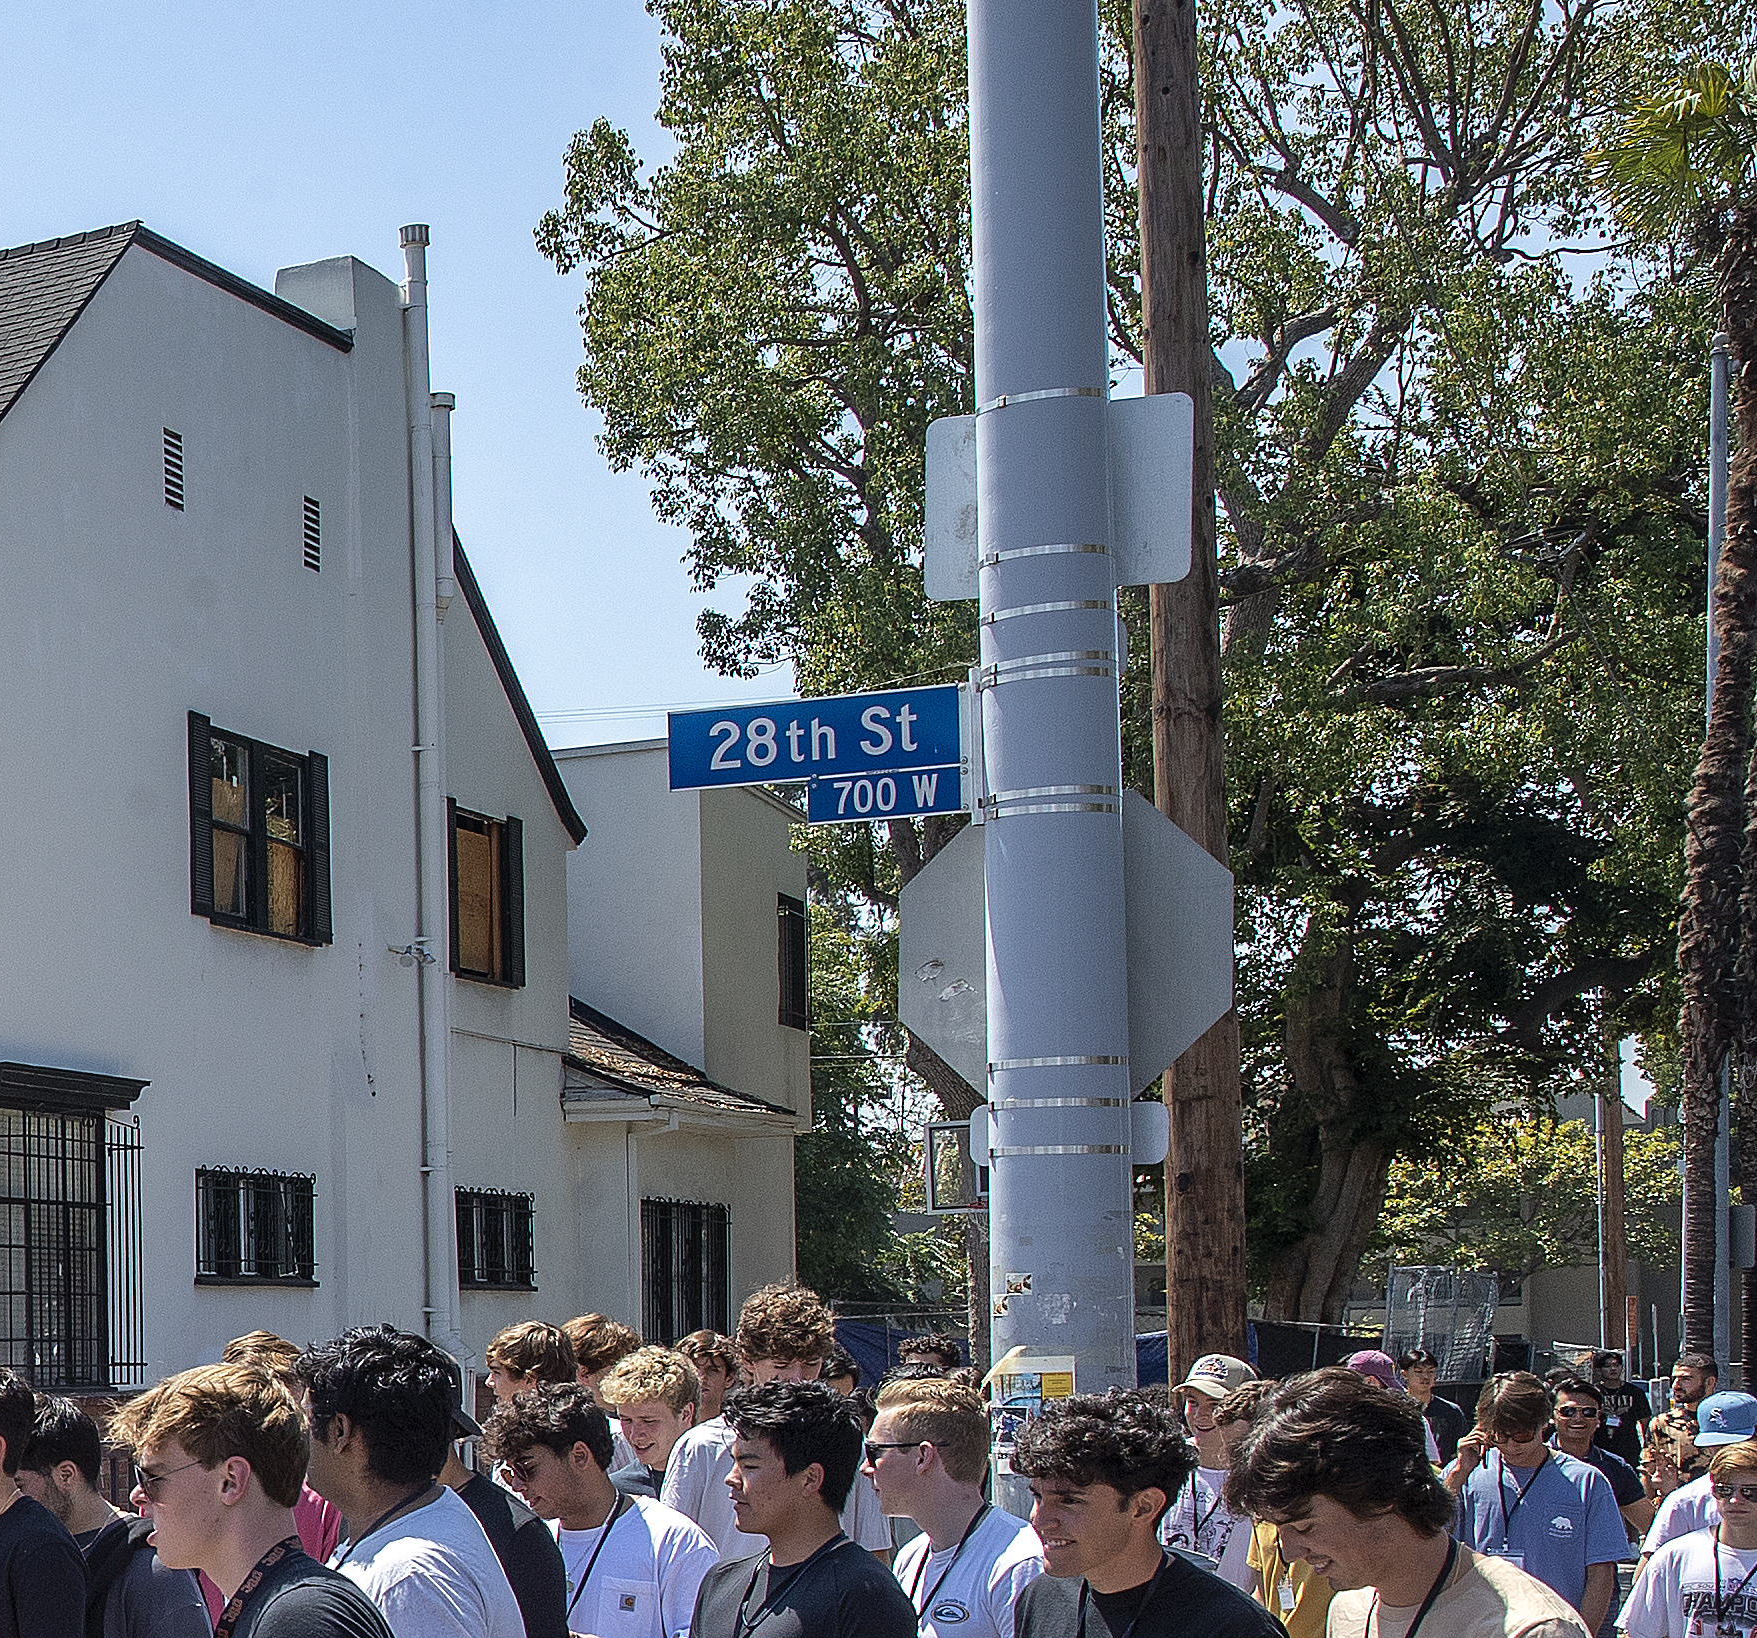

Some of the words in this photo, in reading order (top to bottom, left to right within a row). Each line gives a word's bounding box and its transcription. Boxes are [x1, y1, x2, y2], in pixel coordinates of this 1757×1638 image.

[708, 717, 837, 771] 28th
[859, 703, 919, 756] St
[833, 777, 897, 815] 700
[911, 773, 939, 809] W
